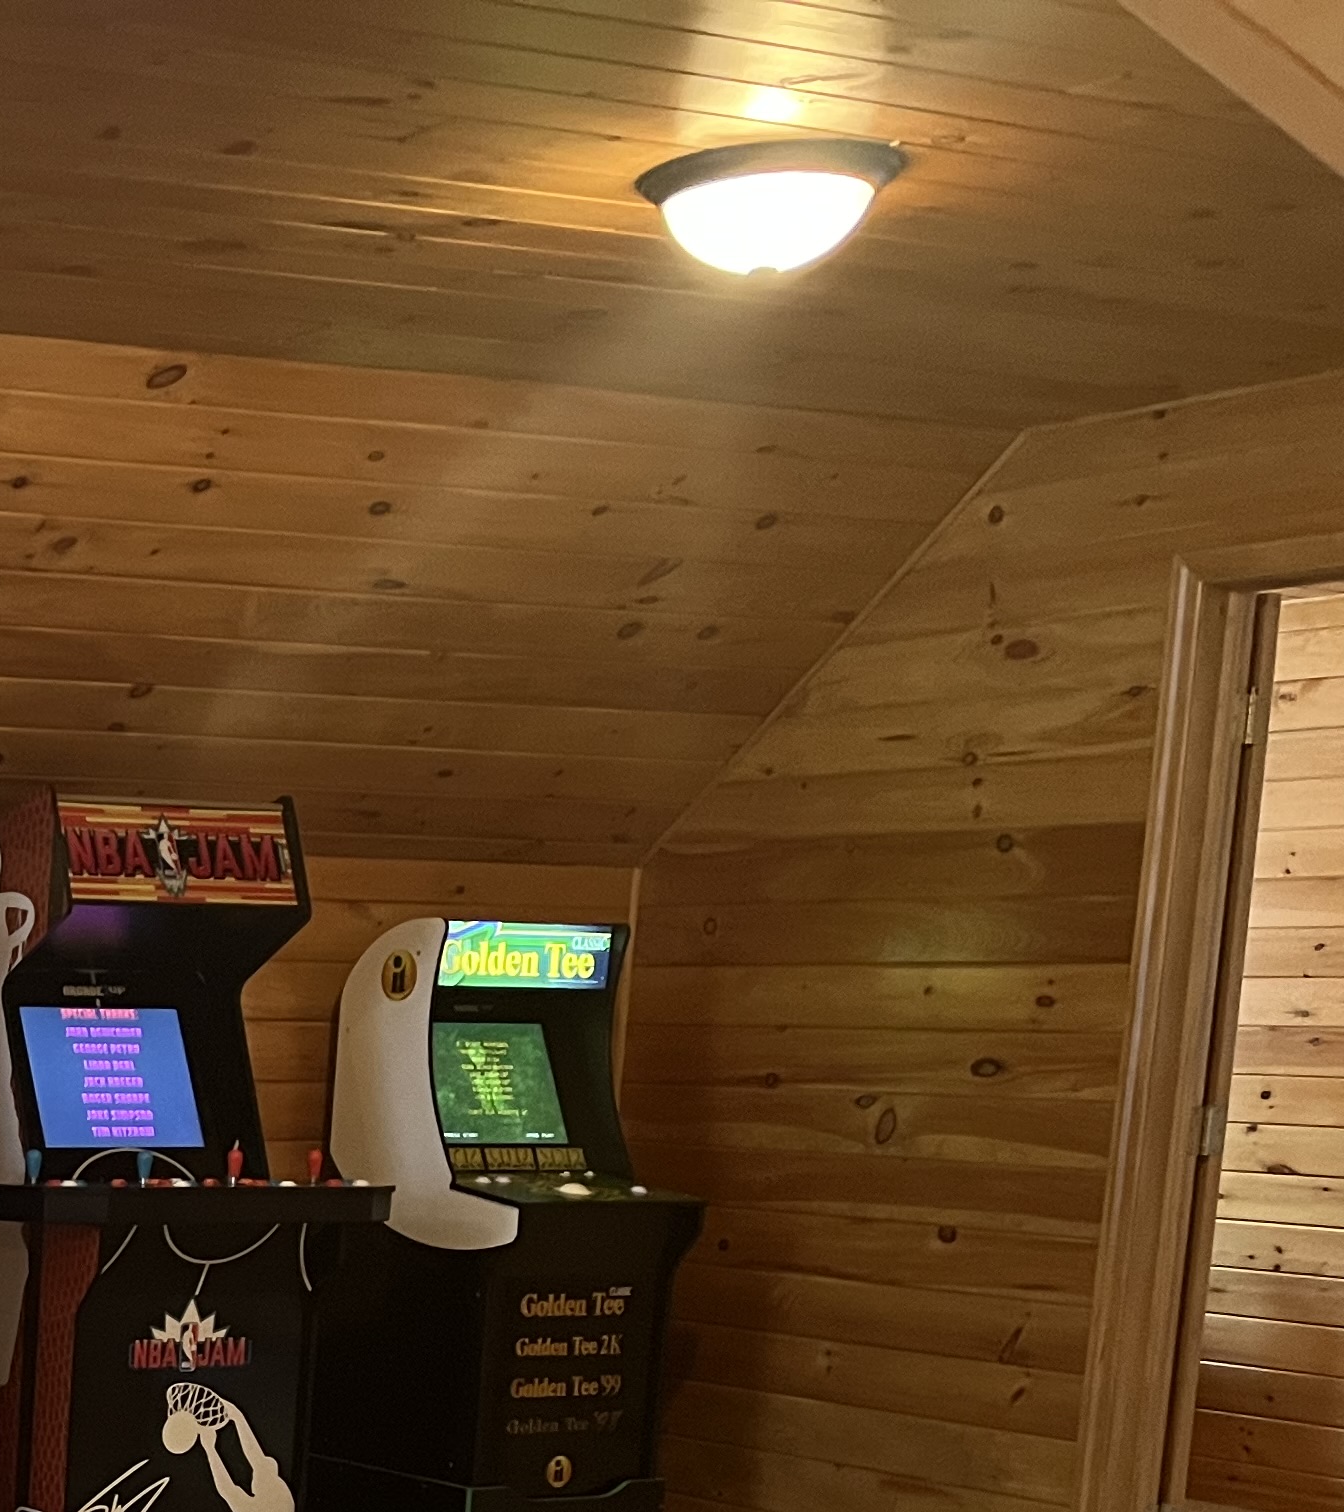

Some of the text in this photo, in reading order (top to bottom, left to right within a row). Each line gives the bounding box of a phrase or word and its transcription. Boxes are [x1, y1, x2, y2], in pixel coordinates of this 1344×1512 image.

[65, 827, 281, 881] NBA JAM
[440, 939, 596, 979] Golden Tee
[520, 1292, 625, 1317] Golden Tee
[133, 1337, 246, 1369] NBA JAM
[515, 1334, 623, 1356] Golden Tee 2K
[510, 1377, 567, 1398] Golden
[572, 1375, 599, 1396] Tee
